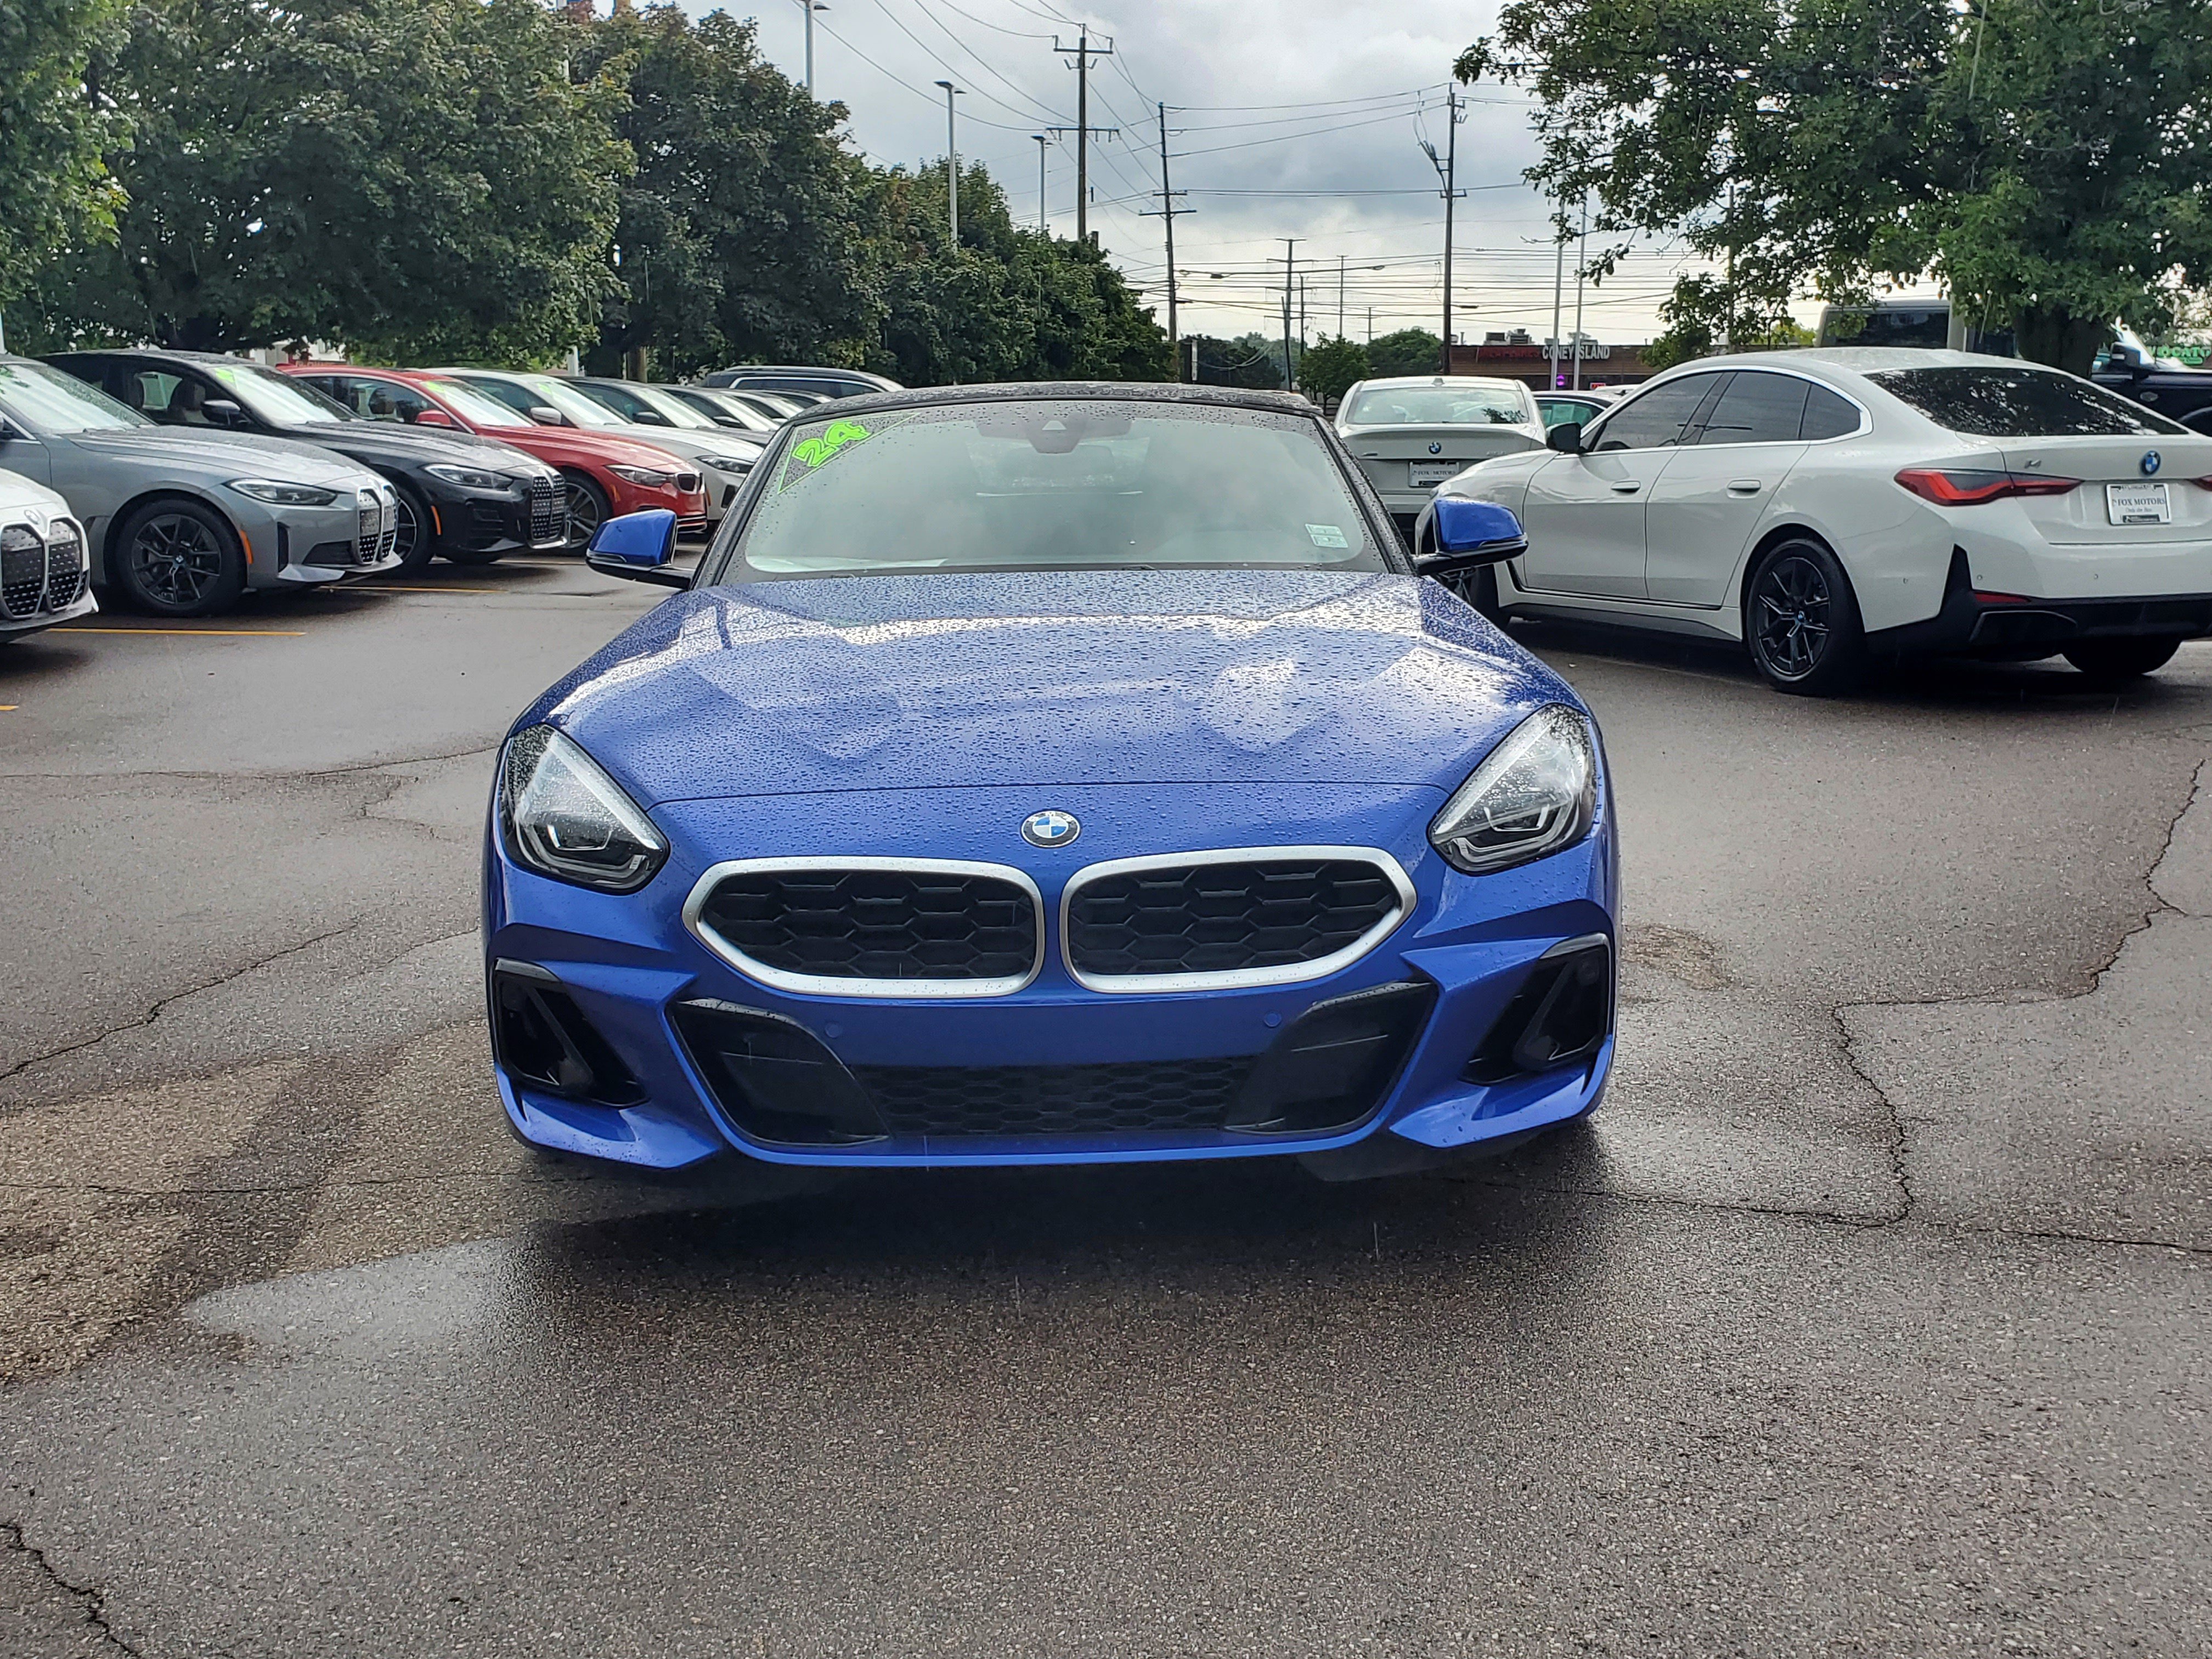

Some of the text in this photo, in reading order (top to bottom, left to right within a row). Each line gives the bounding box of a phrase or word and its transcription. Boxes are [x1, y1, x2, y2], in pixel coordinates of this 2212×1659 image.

[1542, 345, 1574, 360] CONEY
[1576, 345, 1610, 360] SLAND
[792, 422, 872, 467] 24
[2134, 497, 2165, 505] MOTORS
